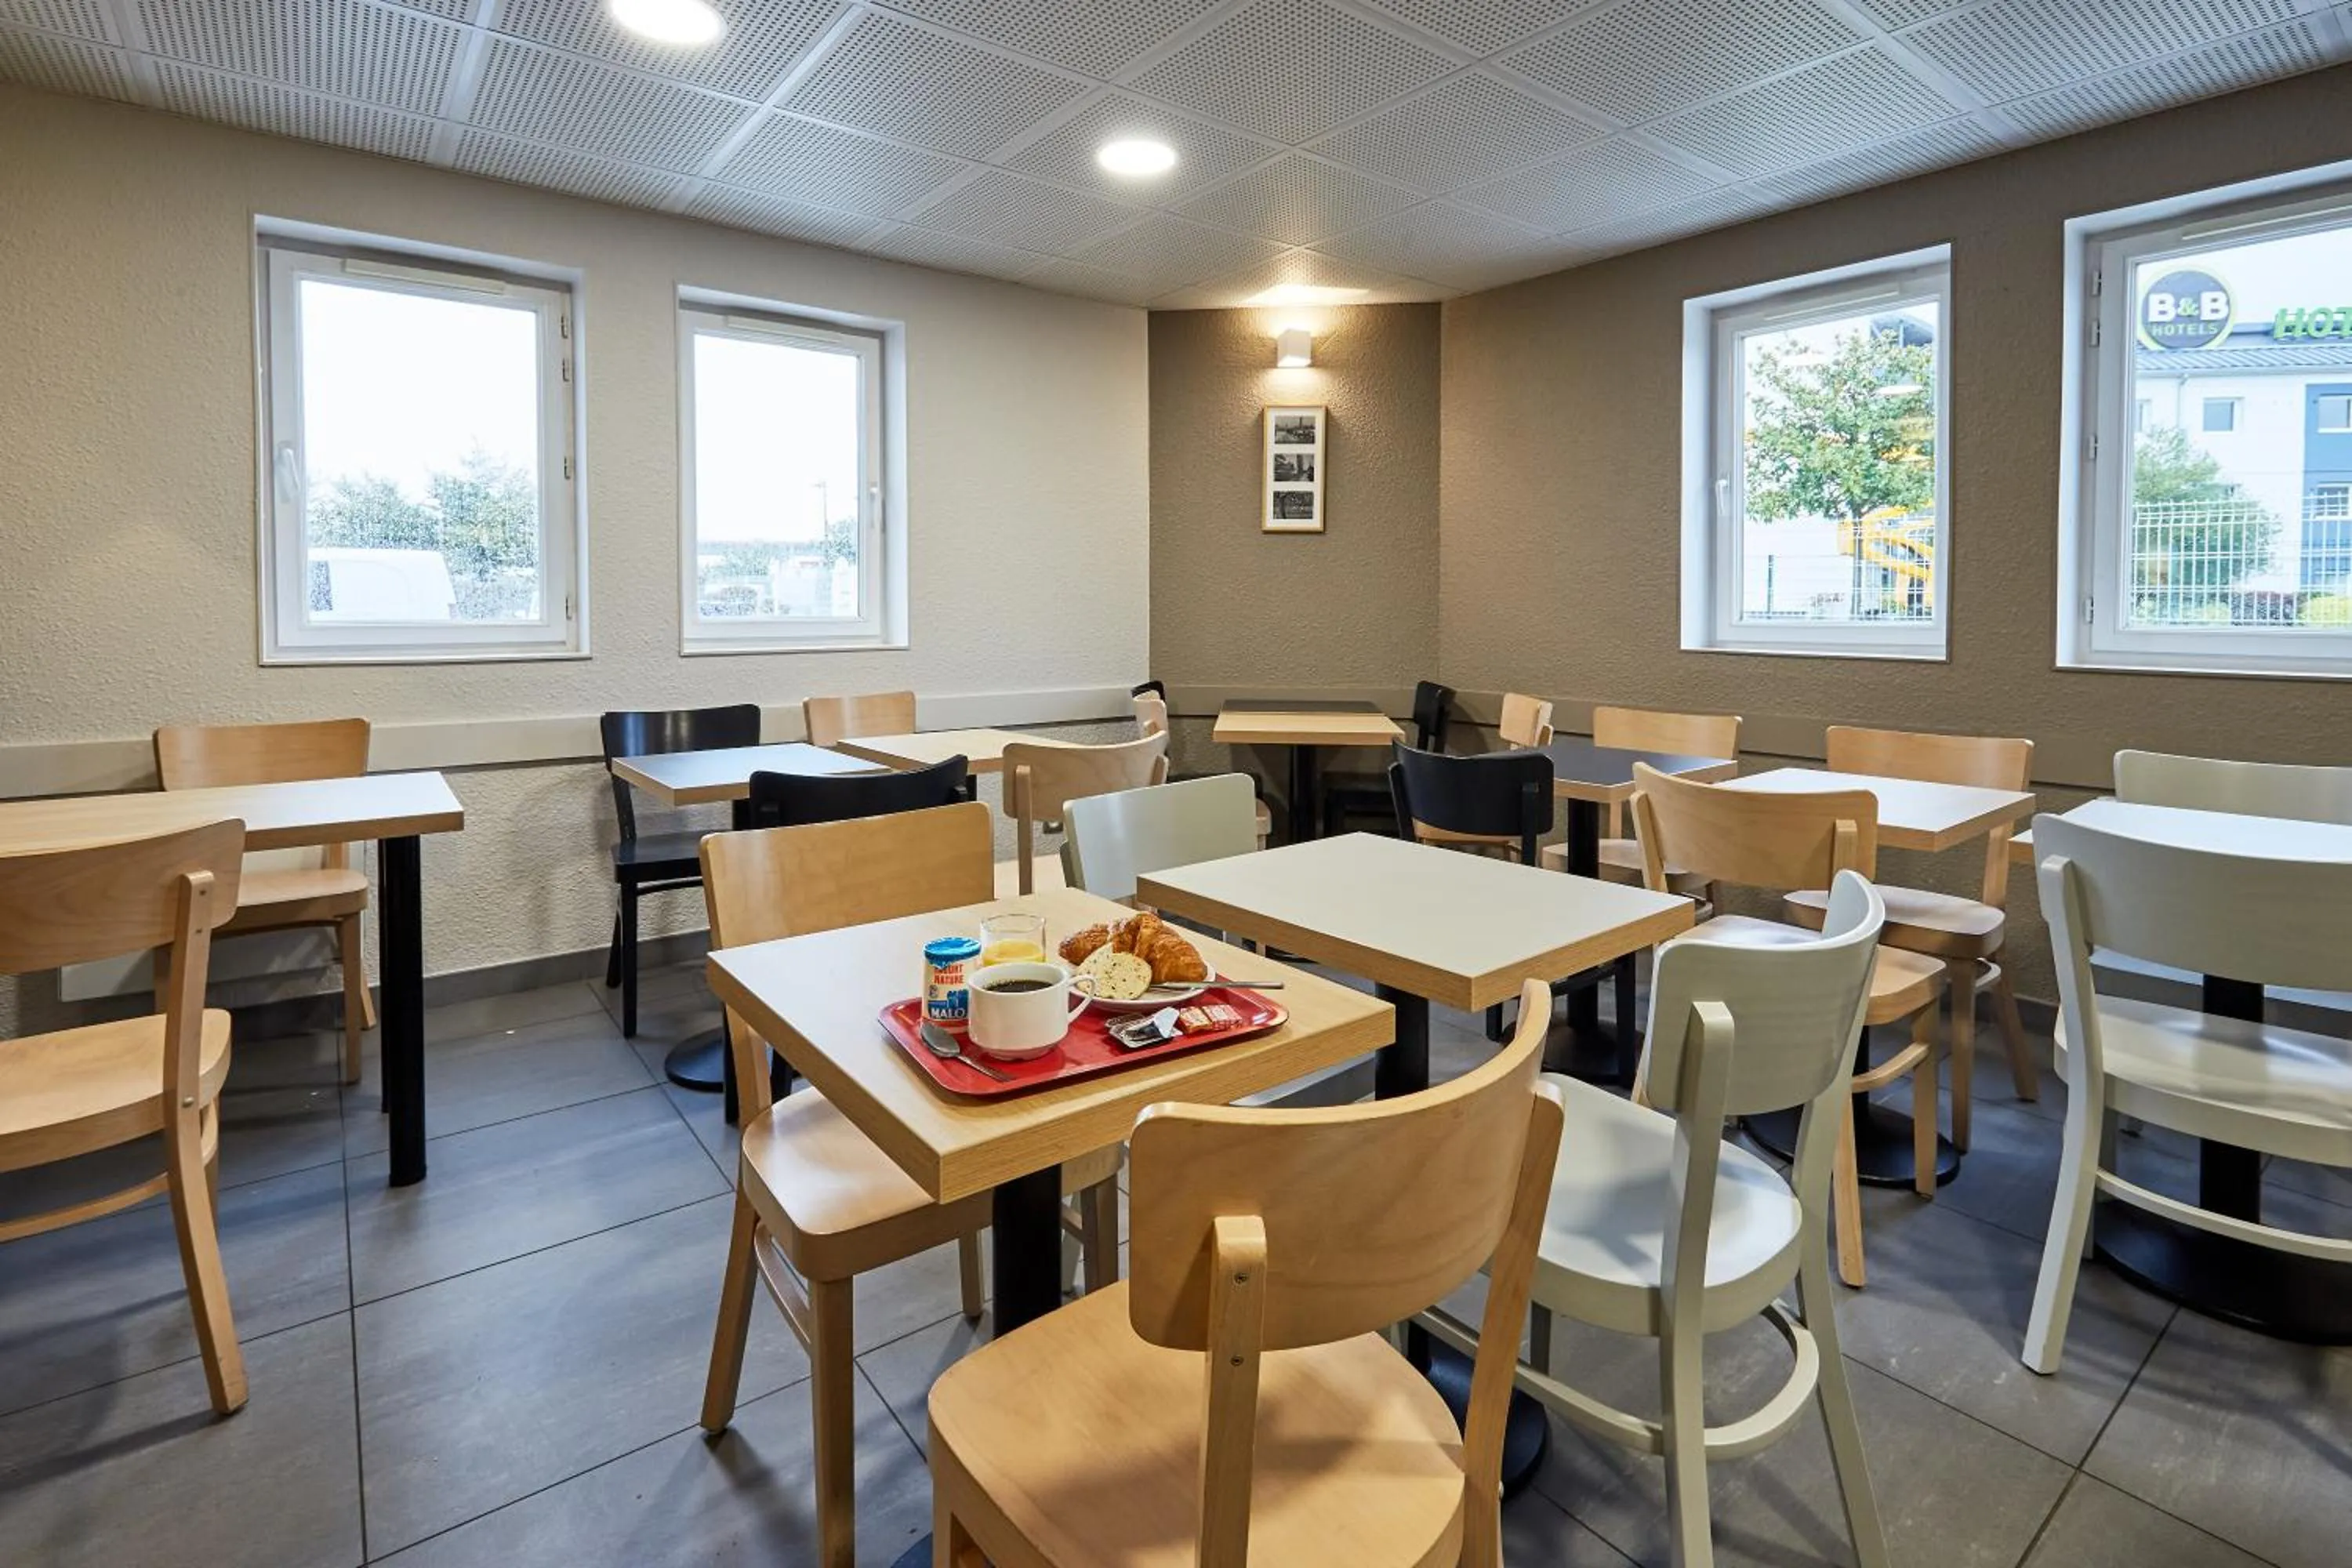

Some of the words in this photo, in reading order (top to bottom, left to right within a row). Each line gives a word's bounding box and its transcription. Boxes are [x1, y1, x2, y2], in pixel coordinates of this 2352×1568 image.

[2148, 291, 2229, 322] B&B
[2151, 322, 2219, 336] HOTELS
[930, 1007, 965, 1019] MALO
